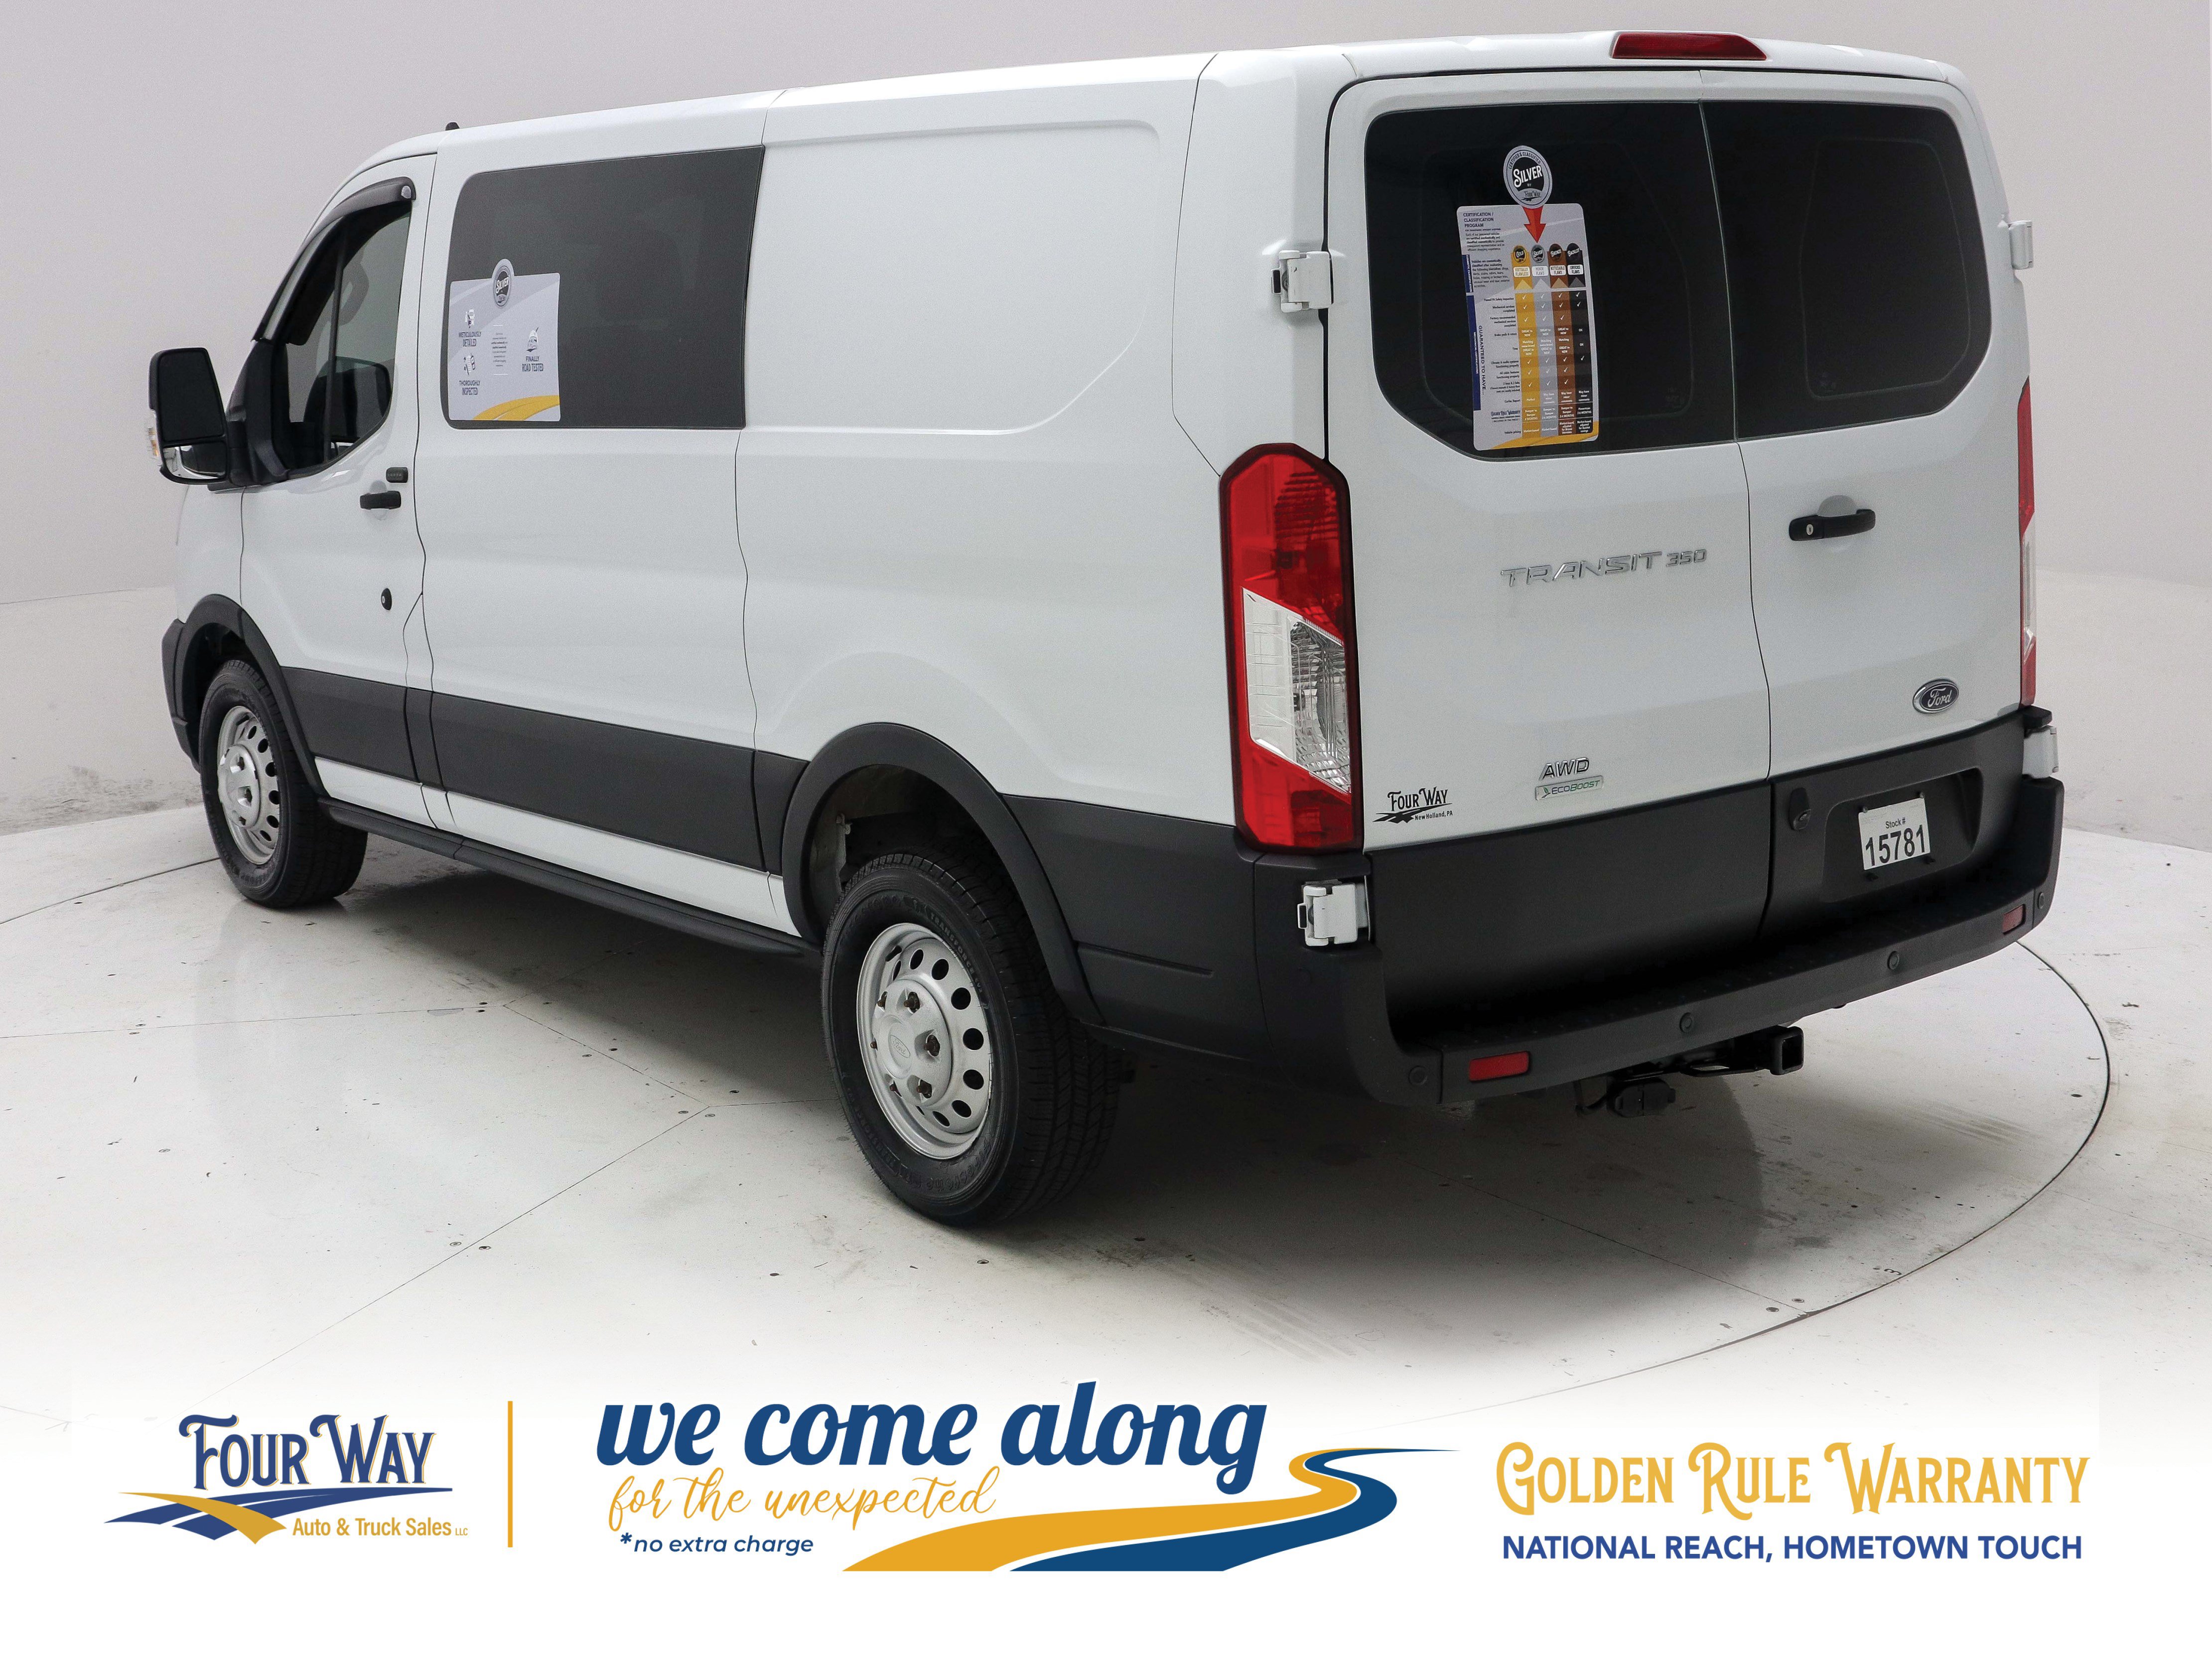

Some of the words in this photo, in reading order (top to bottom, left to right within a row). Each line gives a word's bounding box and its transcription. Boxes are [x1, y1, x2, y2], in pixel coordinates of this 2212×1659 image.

[1508, 152, 1520, 169] CERTIFIED
[1522, 151, 1541, 164] CLASSIFIED
[1513, 165, 1542, 188] SILVER
[496, 277, 509, 293] SILVER
[532, 363, 544, 372] TESTED
[1500, 552, 1662, 587] TRANSIT
[1666, 549, 1707, 567] 350
[1928, 688, 1952, 707] Ford
[1538, 757, 1590, 781] AWD
[1551, 780, 1600, 795] ECOBOOST
[1387, 791, 1419, 811] FOUR
[1418, 787, 1448, 806] WAY
[1426, 811, 1446, 819] Holland,
[1865, 825, 1926, 866] 15781
[930, 912, 975, 975] TRANSFORCE
